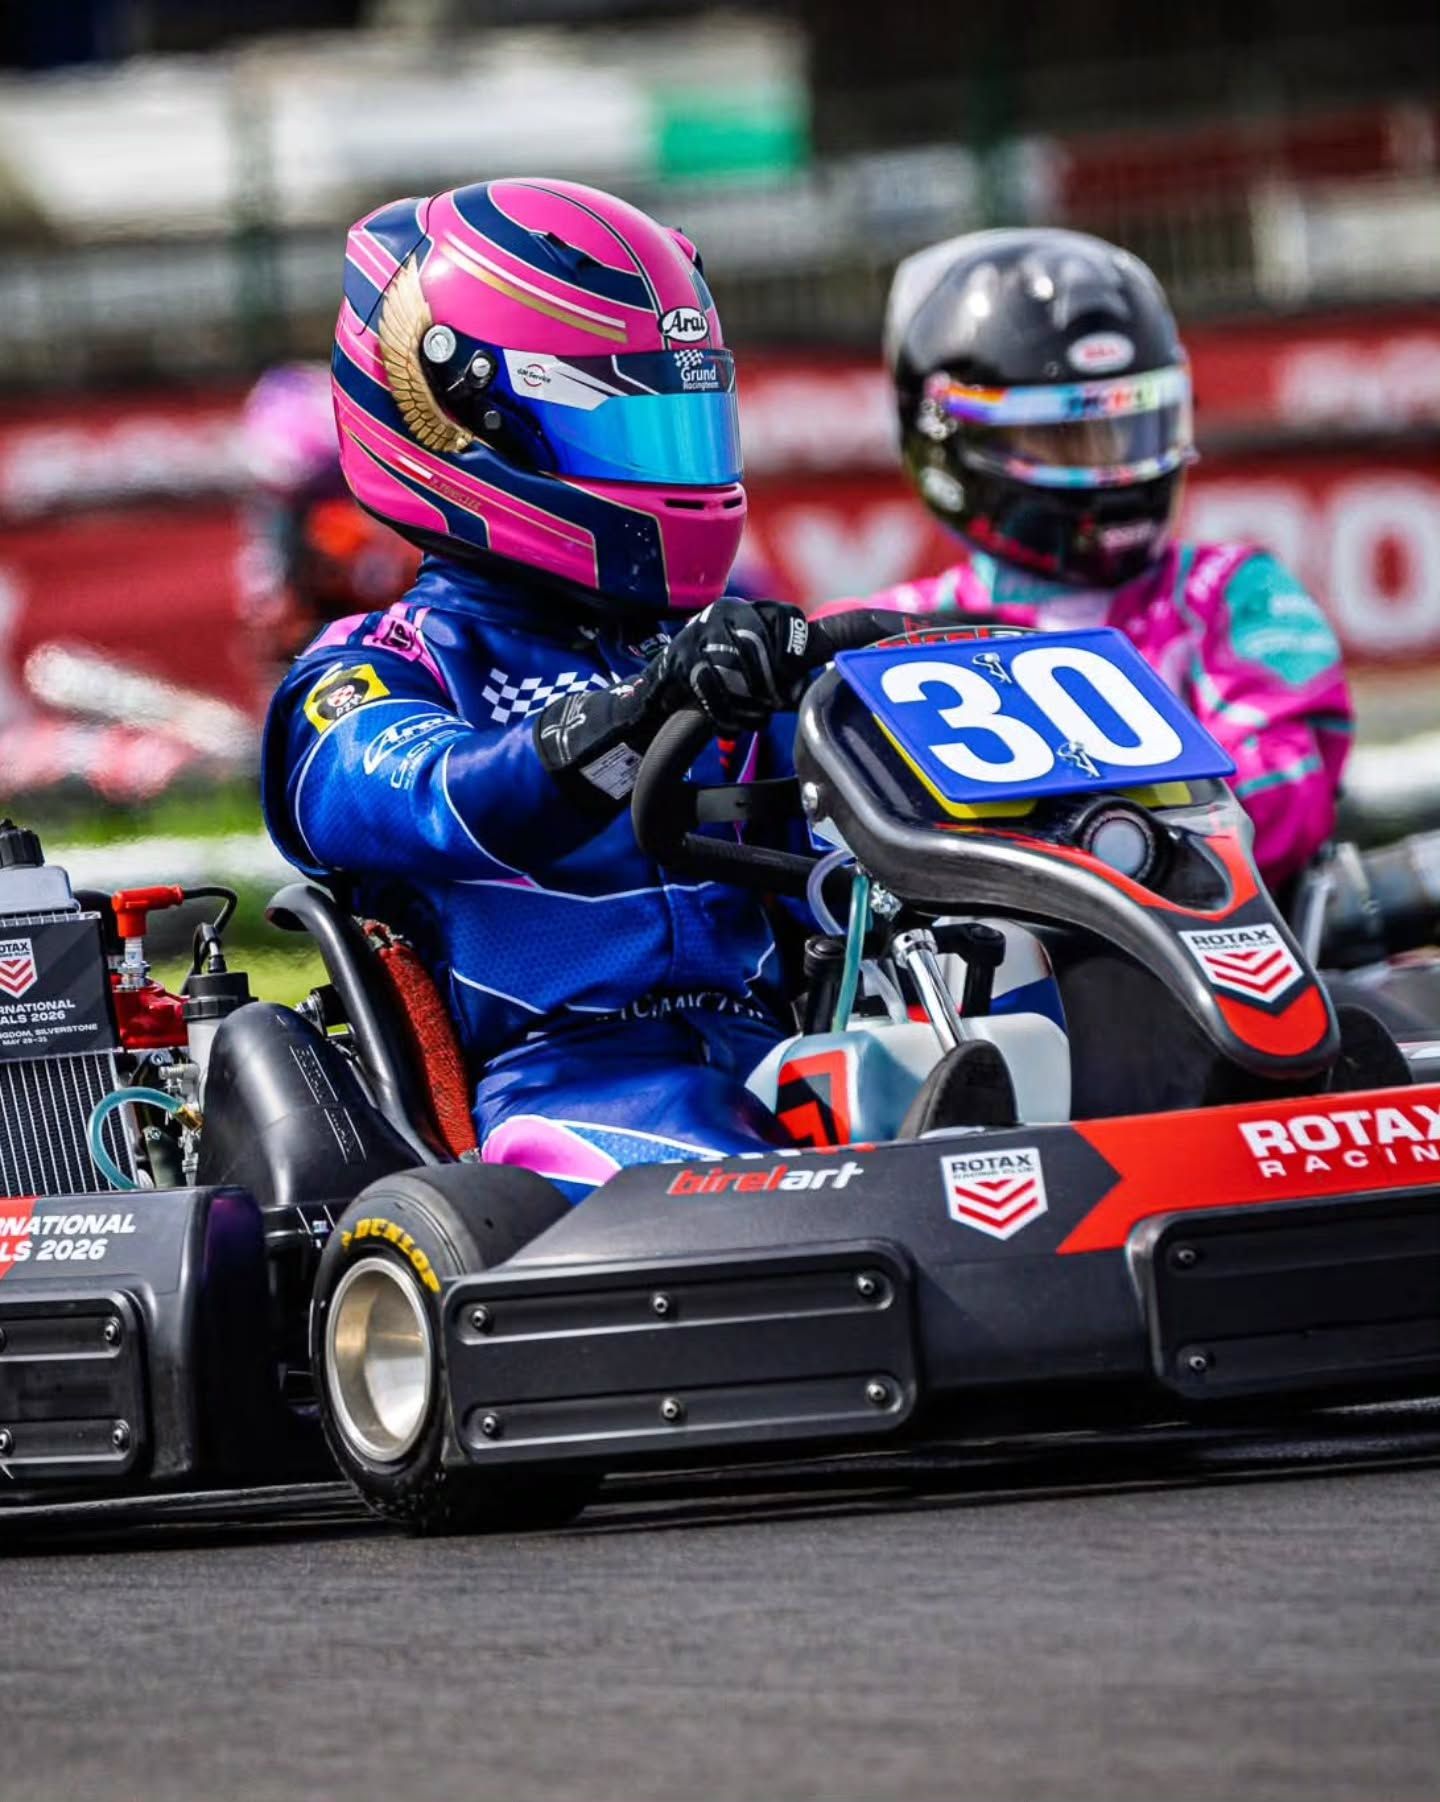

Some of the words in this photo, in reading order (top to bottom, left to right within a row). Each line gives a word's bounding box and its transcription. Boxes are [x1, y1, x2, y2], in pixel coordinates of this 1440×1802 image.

[662, 310, 706, 334] Arai
[680, 363, 717, 381] Grund
[793, 618, 808, 655] OMP
[880, 646, 1184, 783] 30
[1190, 930, 1271, 946] ROTAX
[31, 1010, 66, 1022] 2026
[35, 1023, 98, 1036] SILVERSTONE
[951, 1154, 1032, 1173] ROTAX
[666, 1161, 865, 1196] birelart
[36, 1238, 109, 1261] 2026
[353, 1218, 441, 1293] DUNLOP
